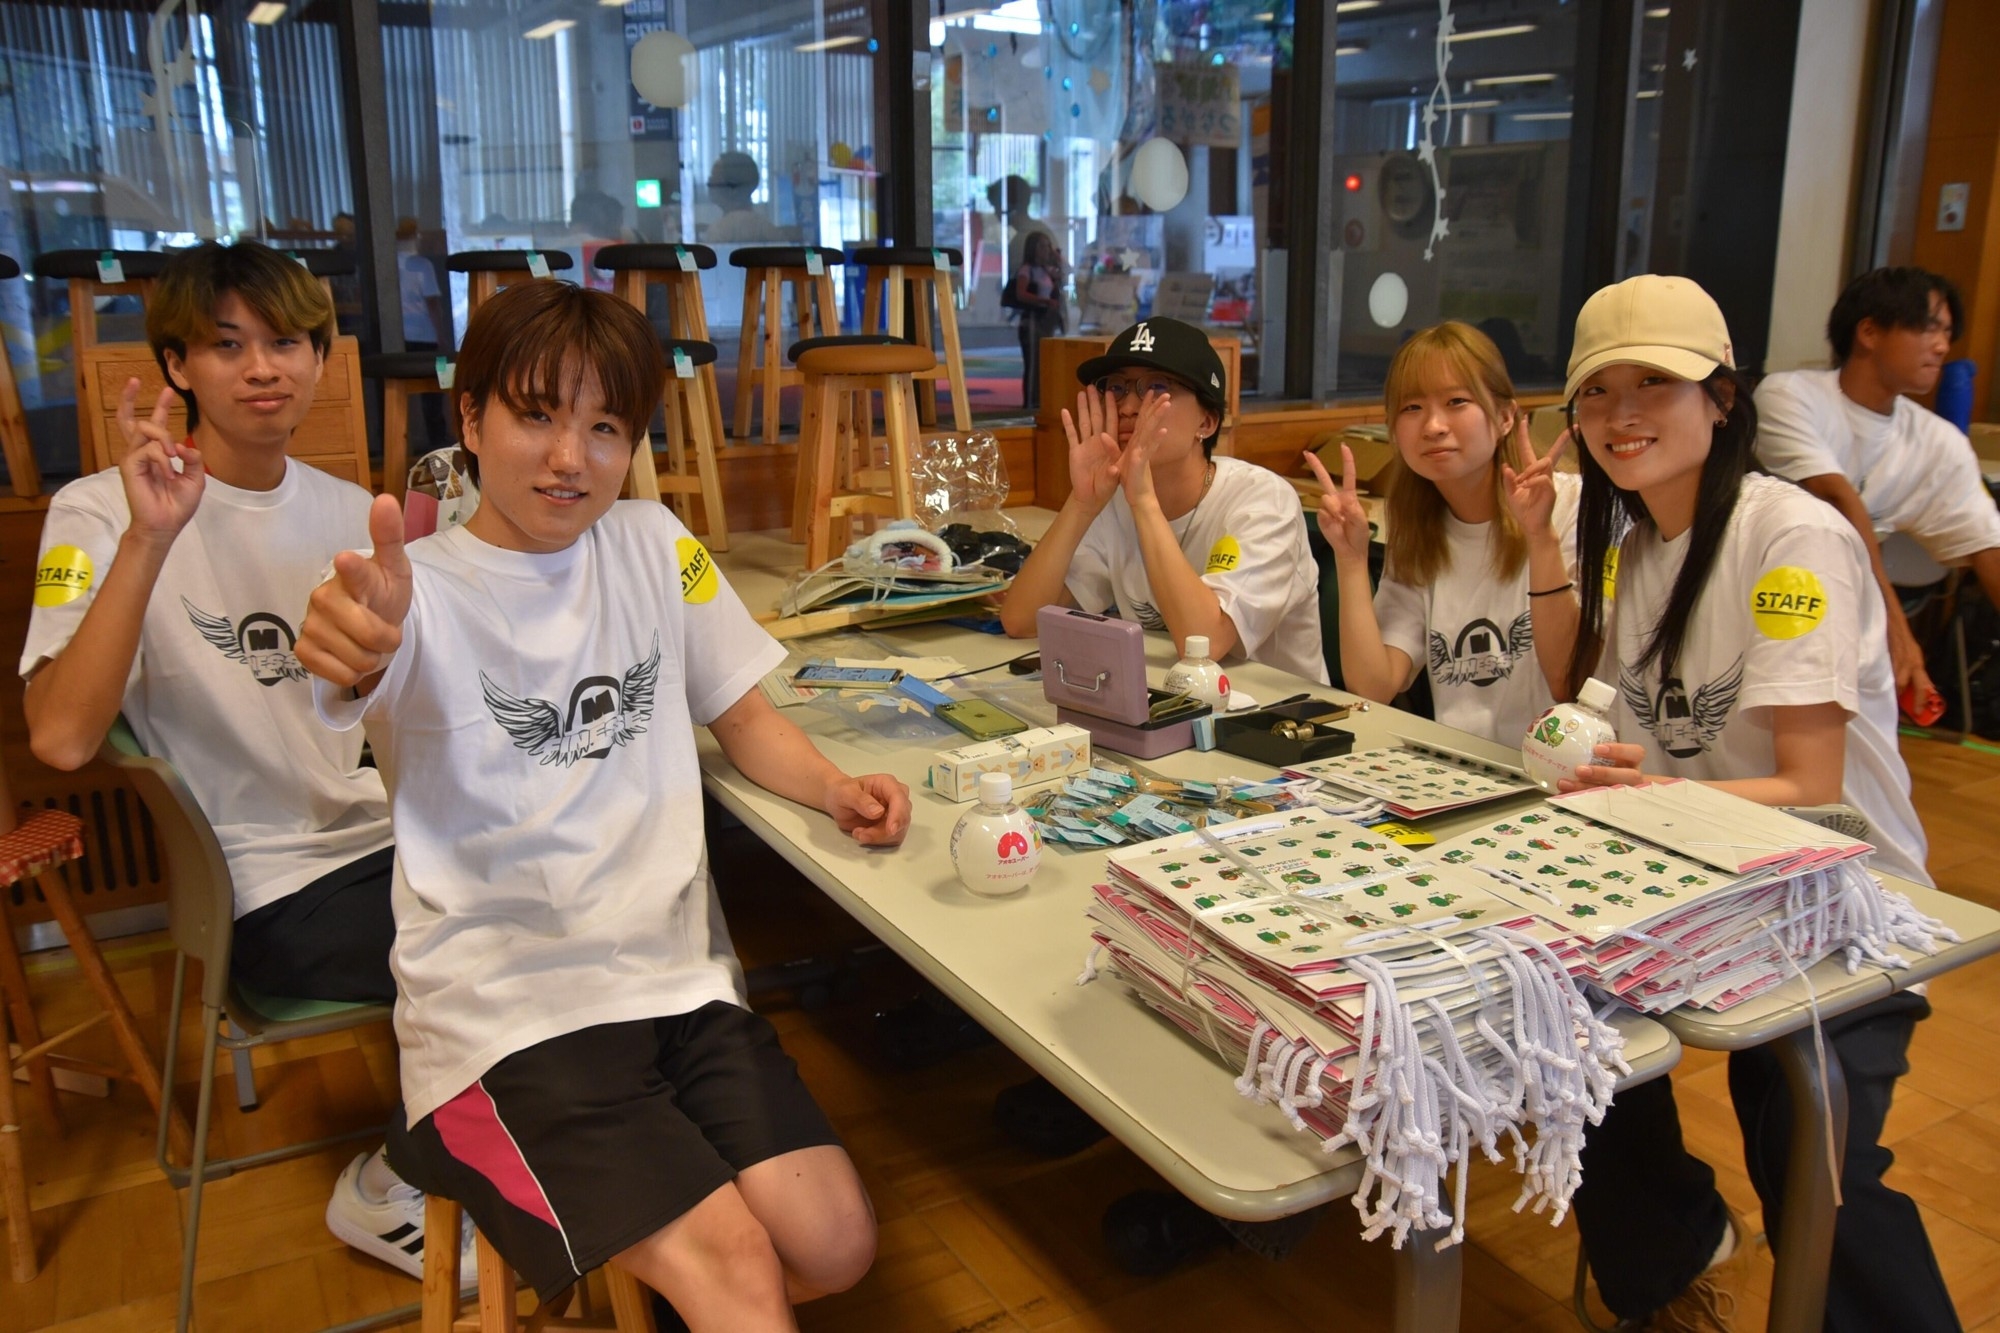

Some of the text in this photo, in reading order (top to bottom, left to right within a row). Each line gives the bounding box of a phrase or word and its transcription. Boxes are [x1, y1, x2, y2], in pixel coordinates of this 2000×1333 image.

[1129, 322, 1155, 352] LA
[36, 567, 89, 583] STAFF
[1756, 591, 1822, 612] STAFF
